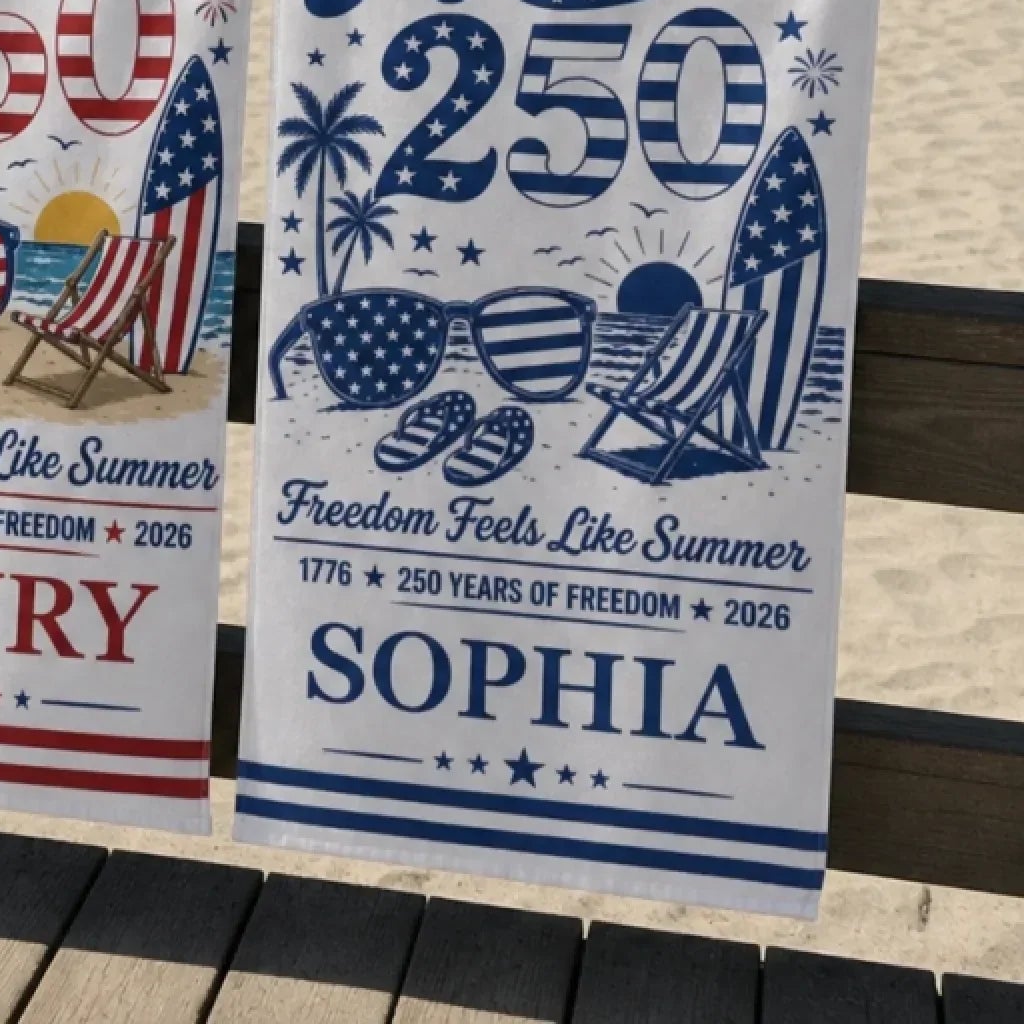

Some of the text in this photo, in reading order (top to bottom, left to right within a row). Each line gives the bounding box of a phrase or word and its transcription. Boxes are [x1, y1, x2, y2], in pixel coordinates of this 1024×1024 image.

[375, 7, 767, 207] 250
[67, 436, 220, 491] Summer
[134, 521, 192, 549] 2026
[277, 479, 811, 572] Freedom Feels Like Summer
[299, 557, 791, 630] 1776 250 YEARS OF FREEDOM 2026
[306, 621, 766, 751] SOPHIA
